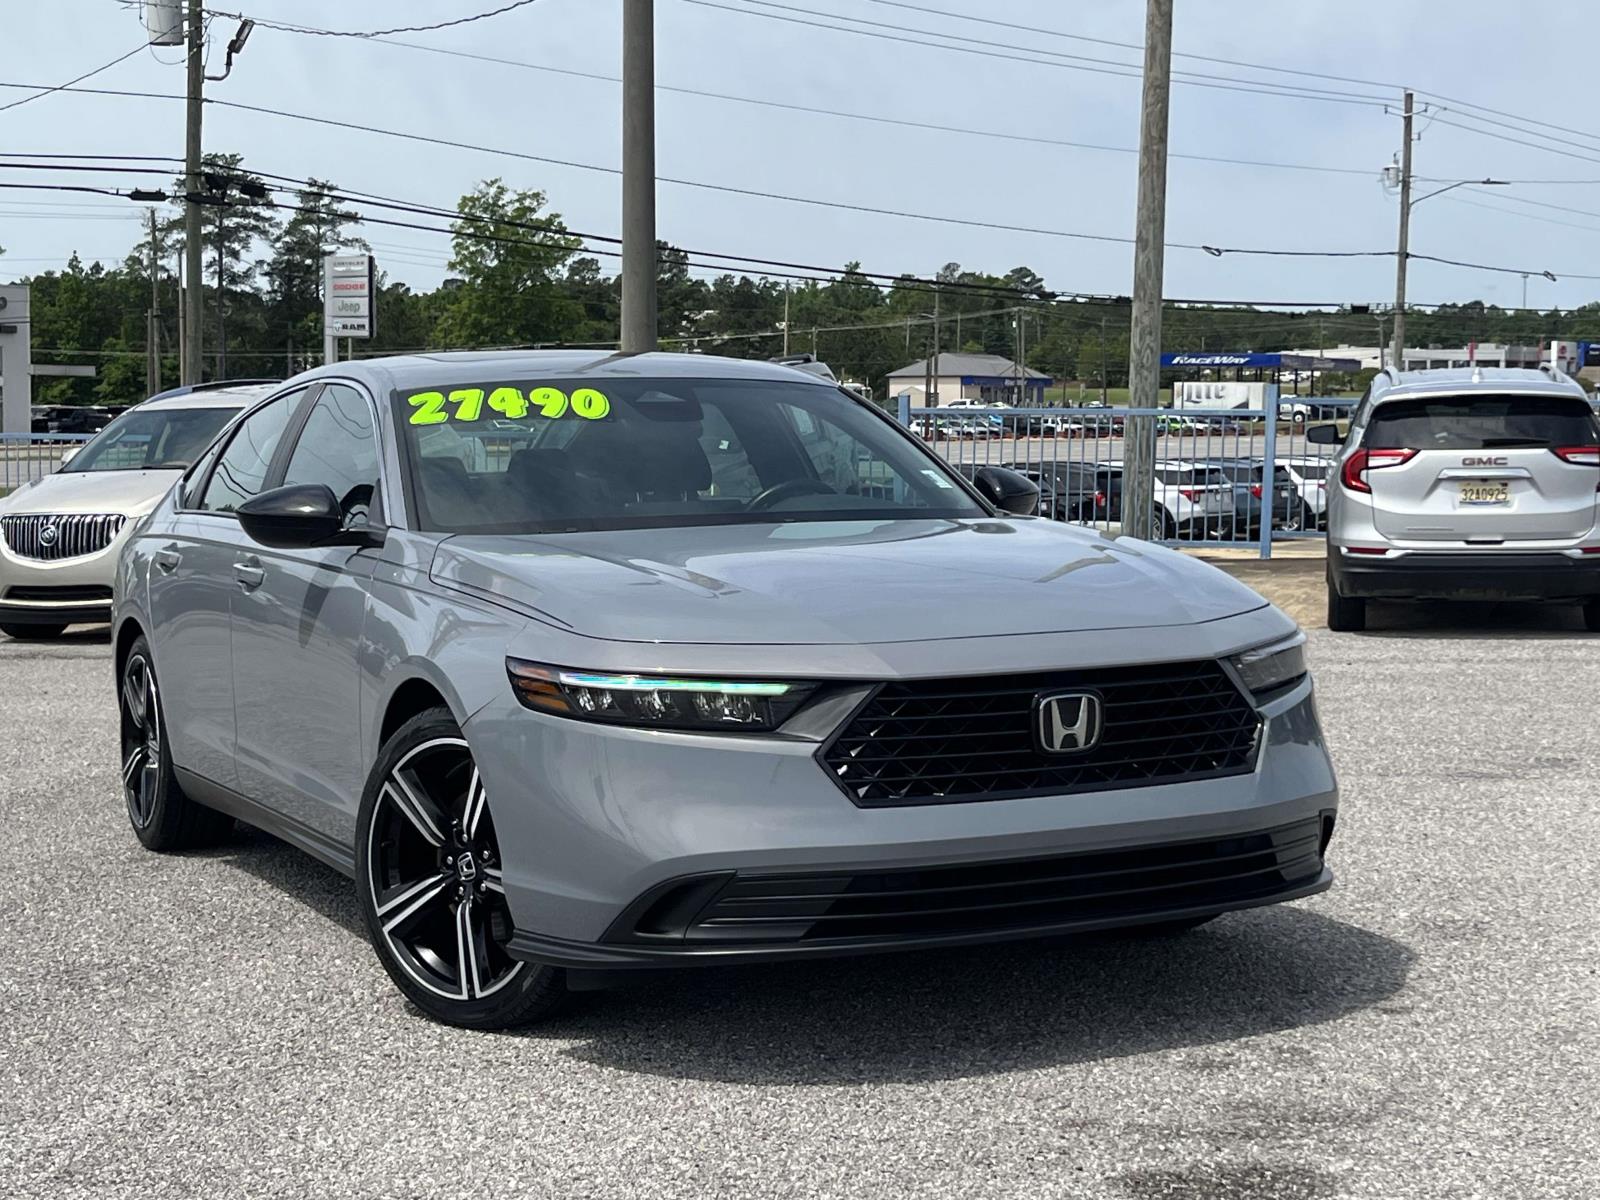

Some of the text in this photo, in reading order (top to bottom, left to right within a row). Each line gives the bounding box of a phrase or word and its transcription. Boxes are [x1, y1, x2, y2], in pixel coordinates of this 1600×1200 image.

[338, 300, 360, 312] Jeep
[408, 387, 611, 425] 27490
[1462, 457, 1508, 466] GMC
[1461, 488, 1508, 501] 32A0925
